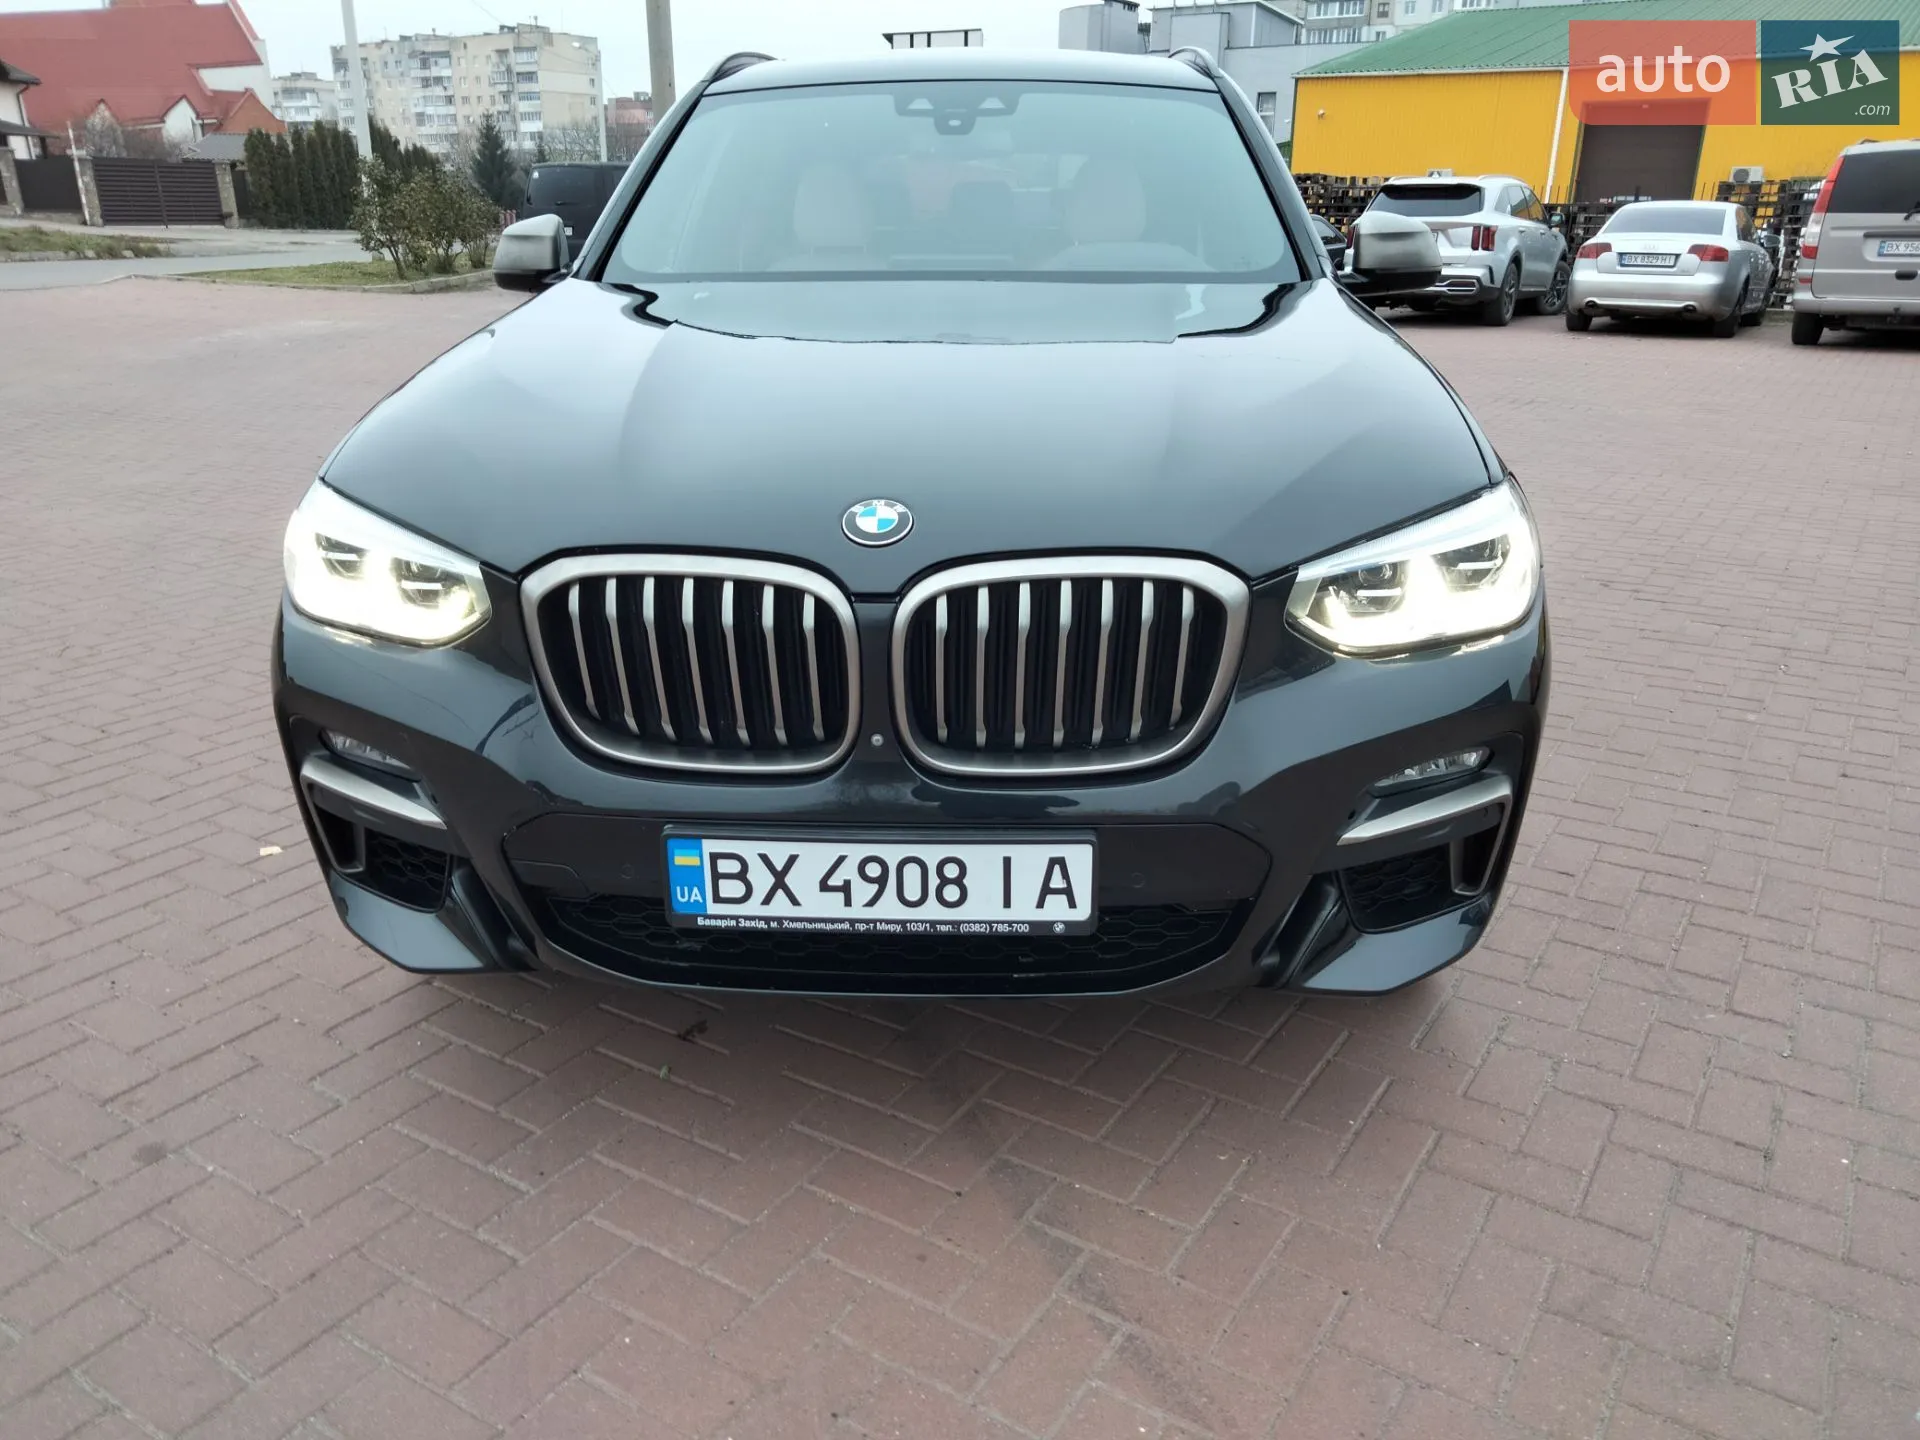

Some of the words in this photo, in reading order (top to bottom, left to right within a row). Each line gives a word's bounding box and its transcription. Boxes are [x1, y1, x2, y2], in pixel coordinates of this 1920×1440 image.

[1886, 243, 1900, 252] BX
[708, 852, 802, 907] BX
[818, 854, 969, 909] 4908
[1000, 856, 1078, 910] IA
[676, 886, 703, 904] UA
[697, 917, 736, 927] Баварія
[738, 918, 768, 928] Захід,
[782, 920, 853, 931] Хмельницький,
[876, 922, 903, 932] Миру,
[905, 922, 934, 933] 103/1,
[959, 923, 990, 933] (0382)
[992, 923, 1030, 933] 785-700
